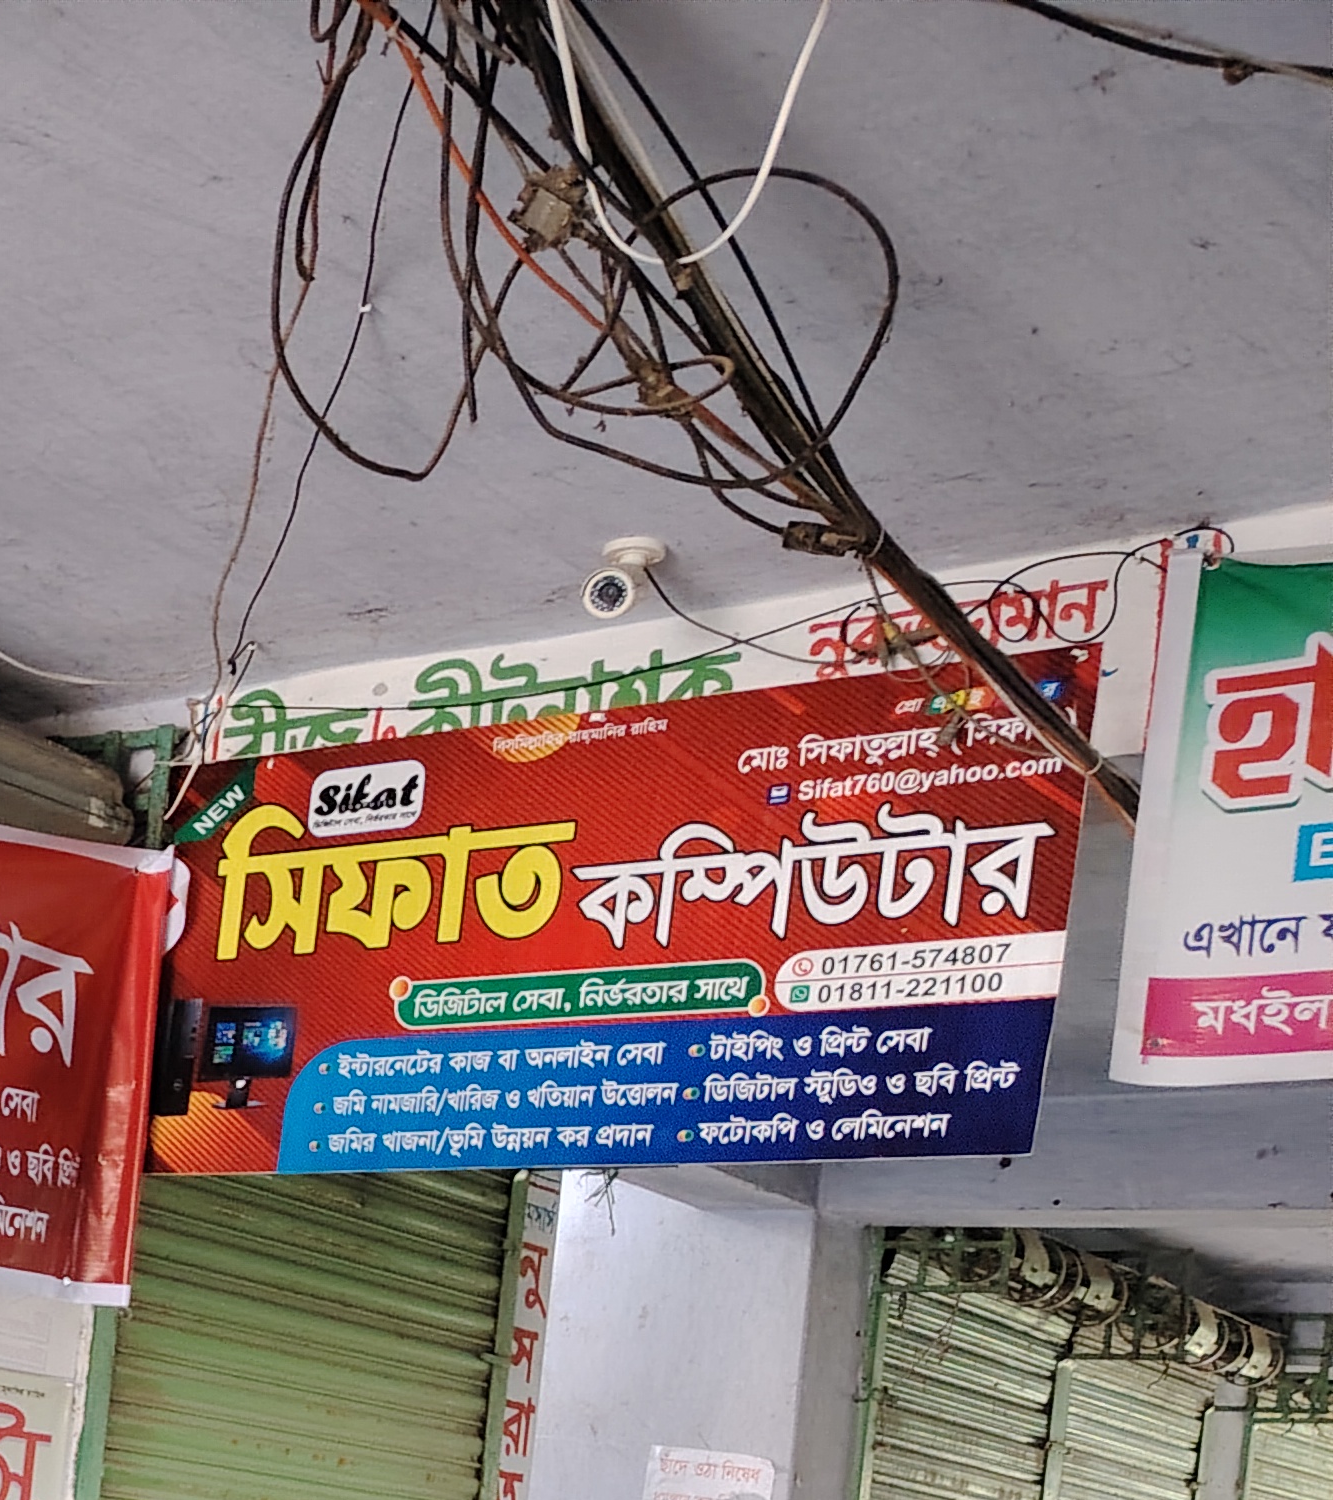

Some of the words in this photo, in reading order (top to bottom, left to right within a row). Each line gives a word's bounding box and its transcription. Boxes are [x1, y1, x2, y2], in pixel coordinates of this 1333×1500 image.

[738, 744, 789, 775] মোঃ
[797, 755, 1064, 801] Sifat760@yahoo.com
[192, 784, 246, 836] NEW
[217, 804, 577, 961] সিফাত
[571, 802, 1057, 951] কম্পিউটার
[1184, 915, 1307, 958] এখানে
[821, 943, 1012, 976] 01761-574807
[413, 988, 506, 1020] ডিজিটাল
[512, 986, 572, 1014] সেবা,
[579, 977, 688, 1010] নির্ভরতার
[696, 975, 750, 1002] সাথে
[817, 971, 1003, 1004] 01811-221100
[336, 1051, 443, 1079] ইন্টারনেটের
[448, 1049, 493, 1074] কাজ
[497, 1048, 520, 1072] বা
[524, 1039, 613, 1070] অনলাইন
[616, 1040, 667, 1066] সেবা
[708, 1031, 785, 1062] টাইপিং
[792, 1034, 812, 1057] ও
[820, 1025, 872, 1057] প্রিন্ট
[876, 1026, 933, 1054] সেবা
[332, 1088, 366, 1117] জমি
[371, 1083, 501, 1117] নামজারি/খারিজ
[505, 1090, 520, 1108] ও
[527, 1079, 596, 1109] খতিয়ান
[600, 1078, 679, 1107] উত্তোলন
[704, 1071, 799, 1102] ডিজিটাল
[885, 1073, 906, 1095] ও
[914, 1061, 960, 1097] ছবি
[964, 1060, 1021, 1093] প্রিন্ট
[0, 1083, 41, 1124] সেবা
[327, 1125, 376, 1155] জমির
[381, 1124, 487, 1158] খাজনা/ভূমি
[490, 1123, 550, 1154] উন্নয়ন
[555, 1124, 593, 1148] কর
[595, 1121, 655, 1148] প্রদান
[698, 1111, 800, 1146] ফটোকপি
[805, 1118, 826, 1140] ও
[831, 1107, 952, 1142] লেমিনেশন
[6, 1148, 21, 1174] ও
[25, 1144, 56, 1188] ছবি
